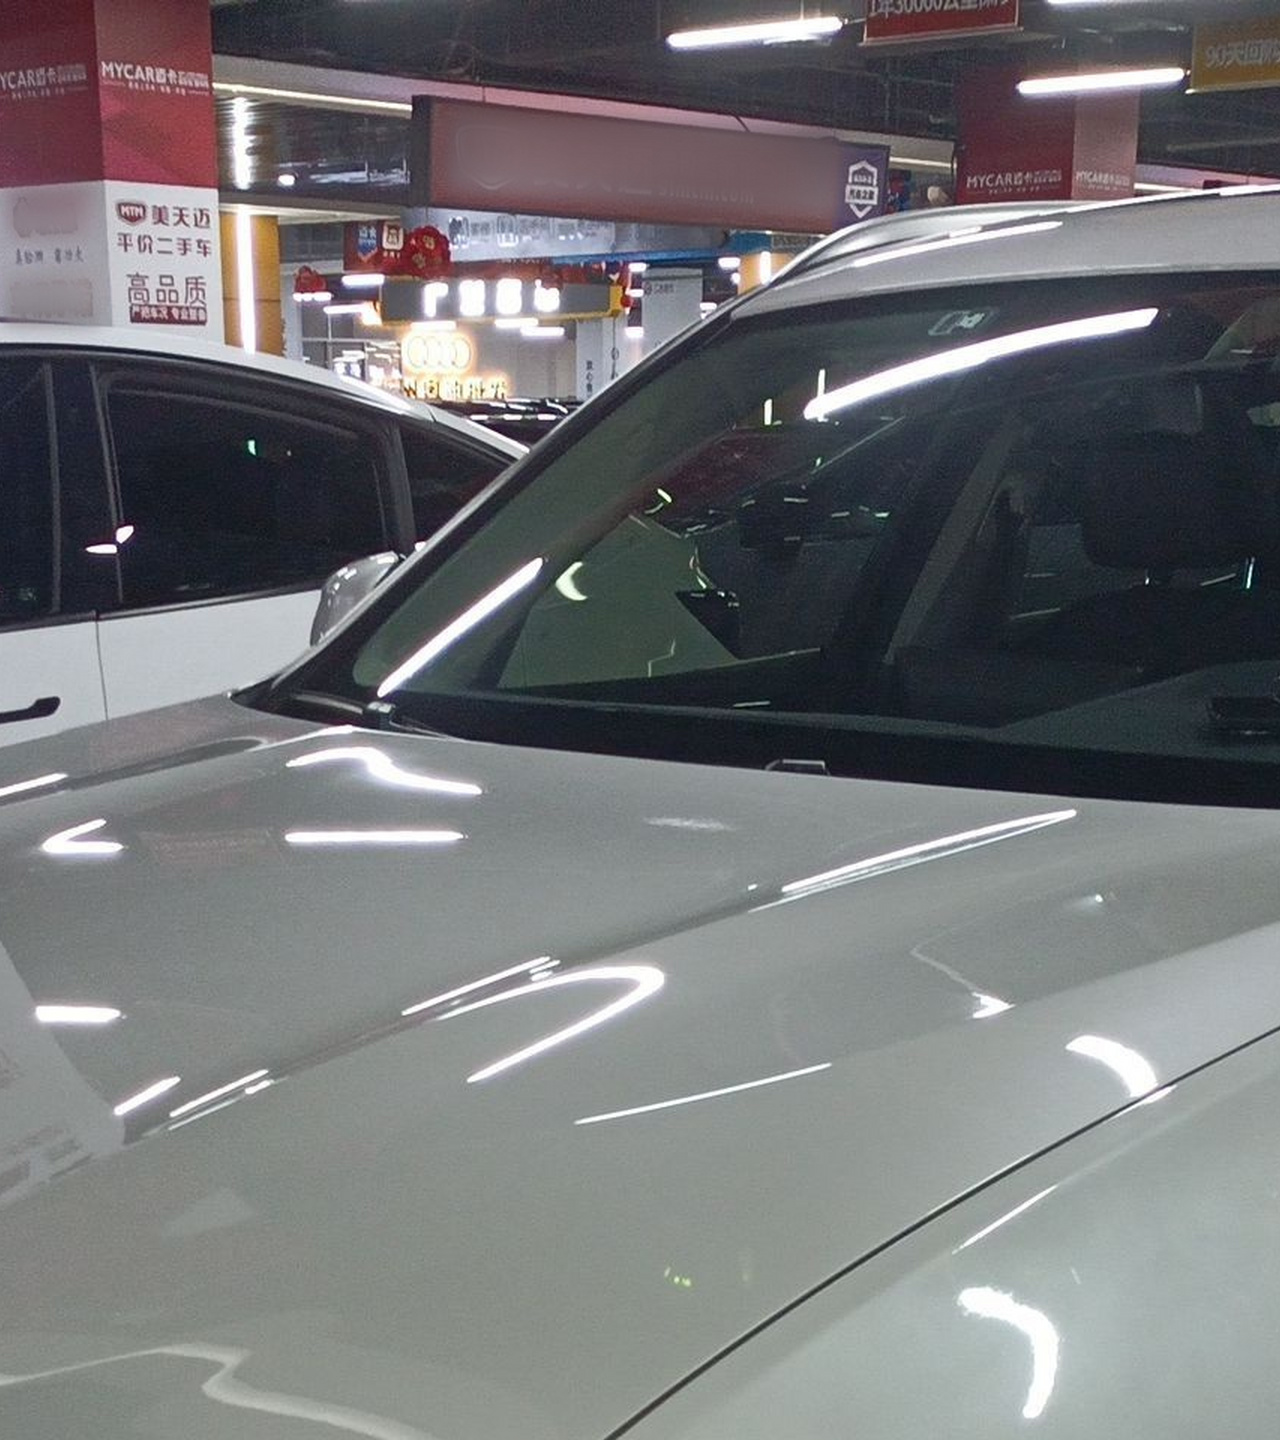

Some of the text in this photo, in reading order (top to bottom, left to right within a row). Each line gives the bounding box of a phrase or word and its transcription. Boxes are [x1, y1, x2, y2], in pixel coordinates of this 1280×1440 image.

[152, 205, 211, 229] 美天迈
[117, 233, 212, 257] 平价二手车
[127, 273, 208, 309] 高品质
